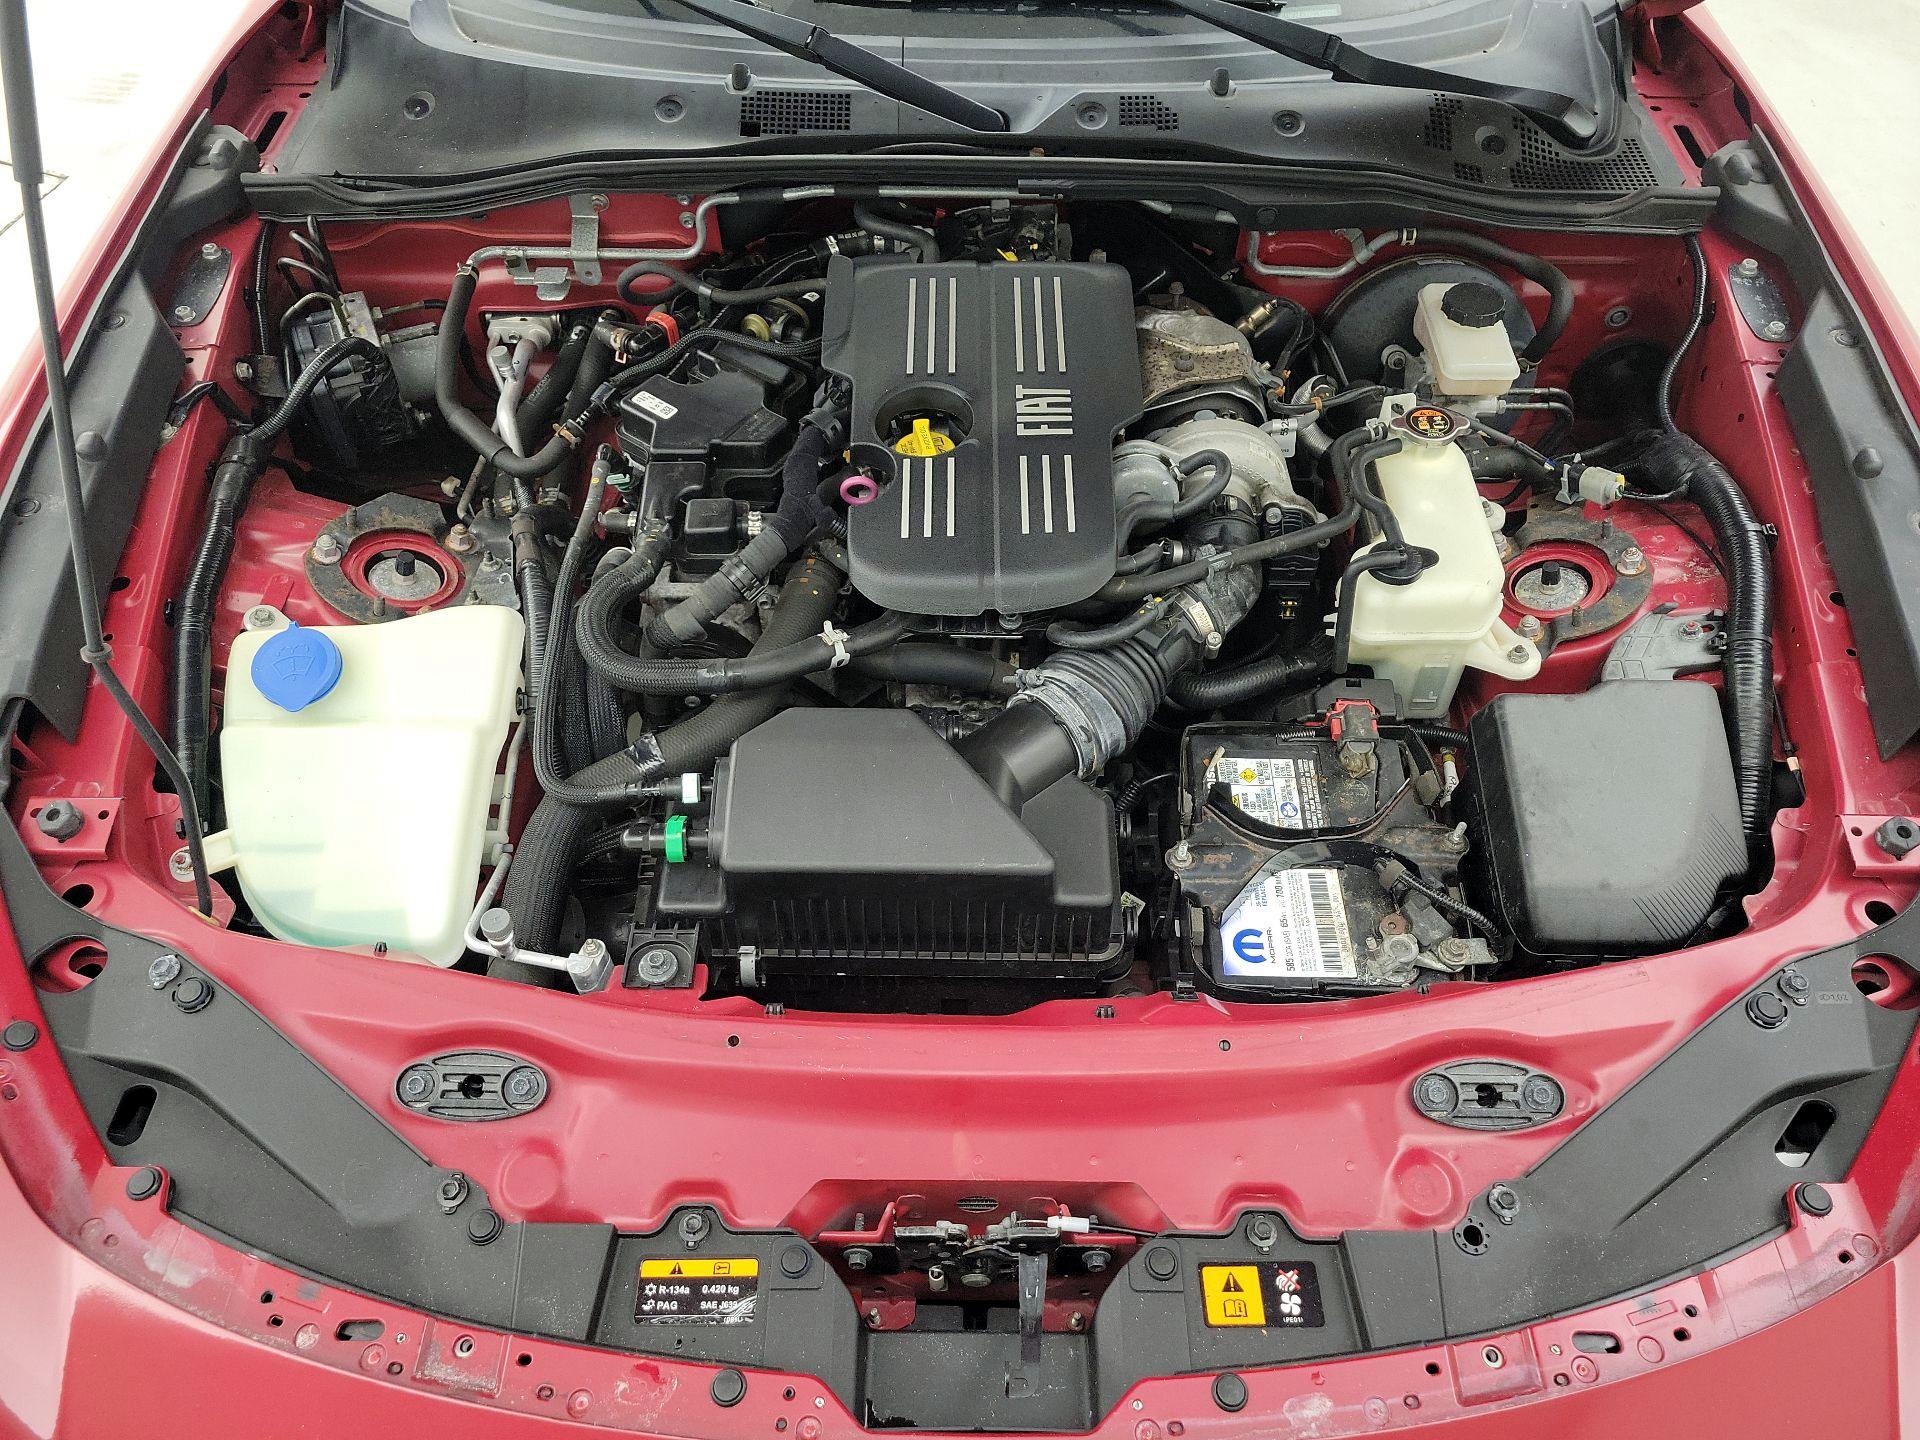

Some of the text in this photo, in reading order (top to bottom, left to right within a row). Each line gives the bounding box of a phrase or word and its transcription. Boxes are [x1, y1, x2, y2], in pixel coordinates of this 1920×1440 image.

[1016, 385, 1073, 435] FIAT
[659, 1284, 740, 1296] R-134a 0.420 kg
[656, 1301, 678, 1310] PAG
[700, 1300, 718, 1309] SAE
